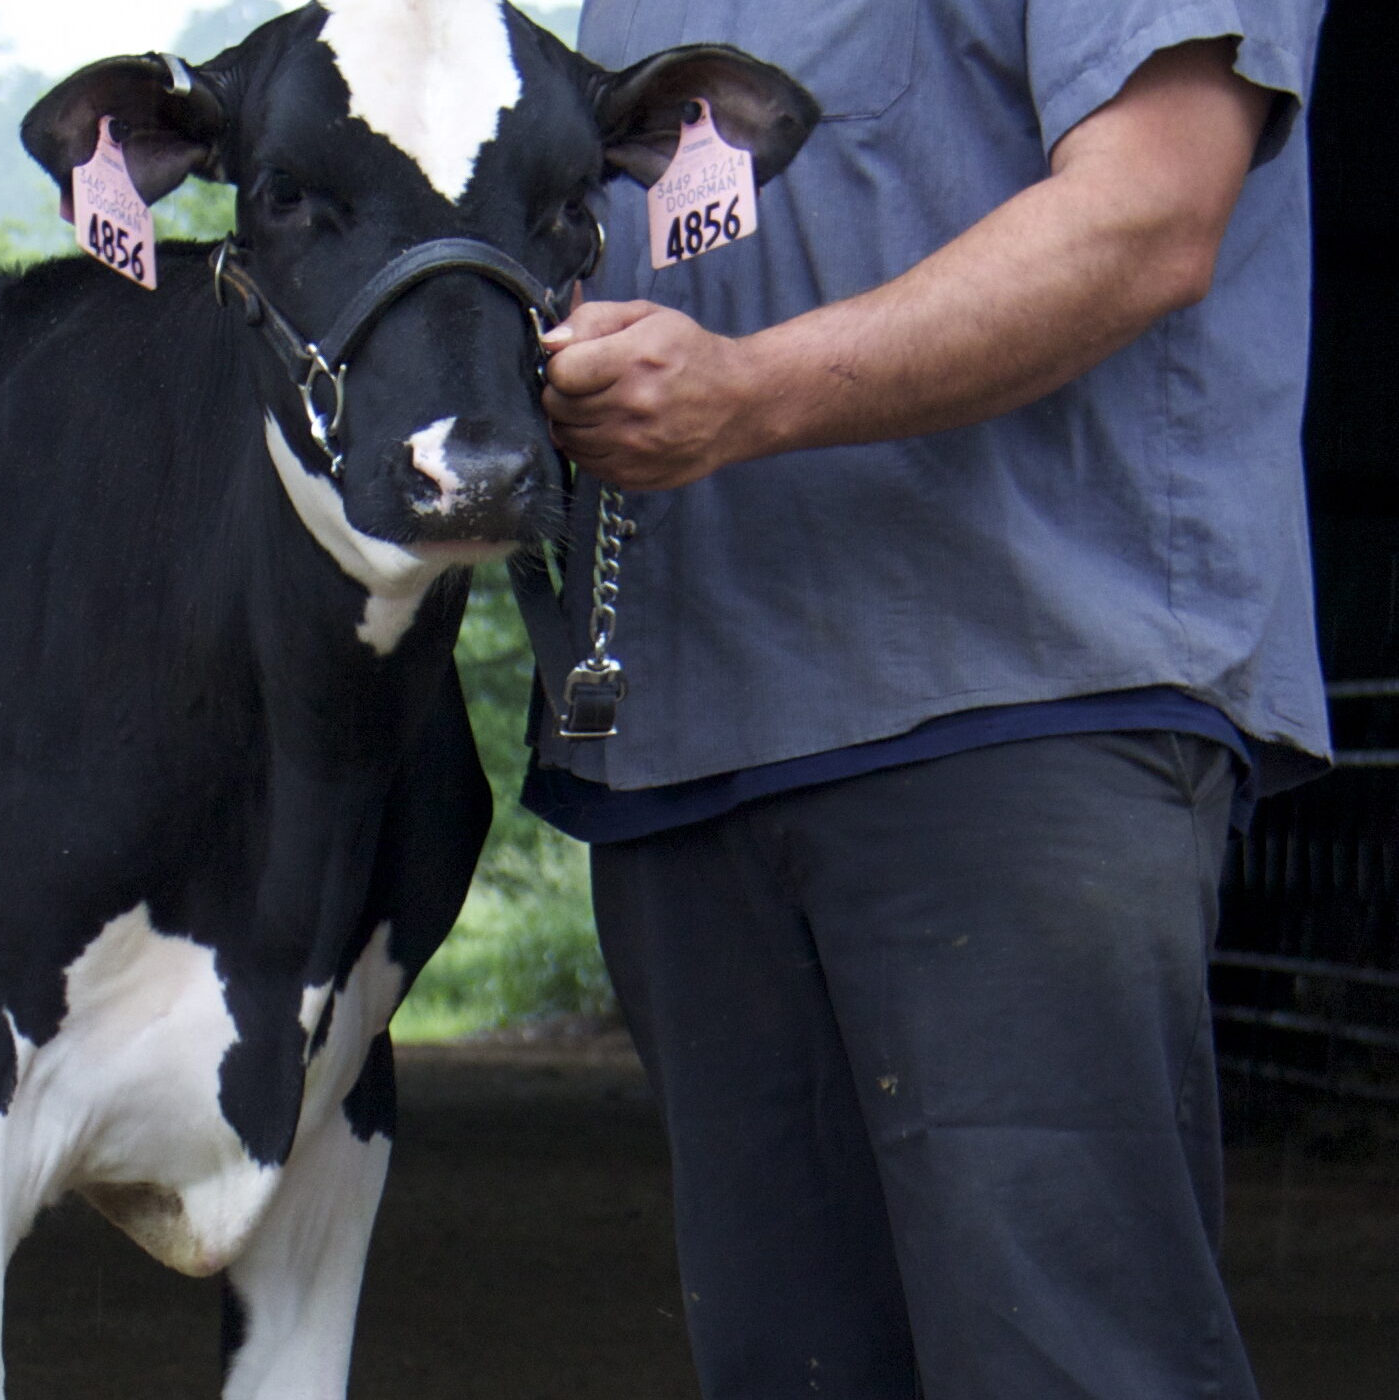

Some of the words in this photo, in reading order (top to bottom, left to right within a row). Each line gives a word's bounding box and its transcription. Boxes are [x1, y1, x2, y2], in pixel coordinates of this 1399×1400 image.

[656, 173, 691, 200] 3449
[701, 151, 745, 183] 12/14
[665, 173, 737, 213] DOORMAN
[88, 212, 145, 282] 4856
[666, 193, 740, 261] 4856
